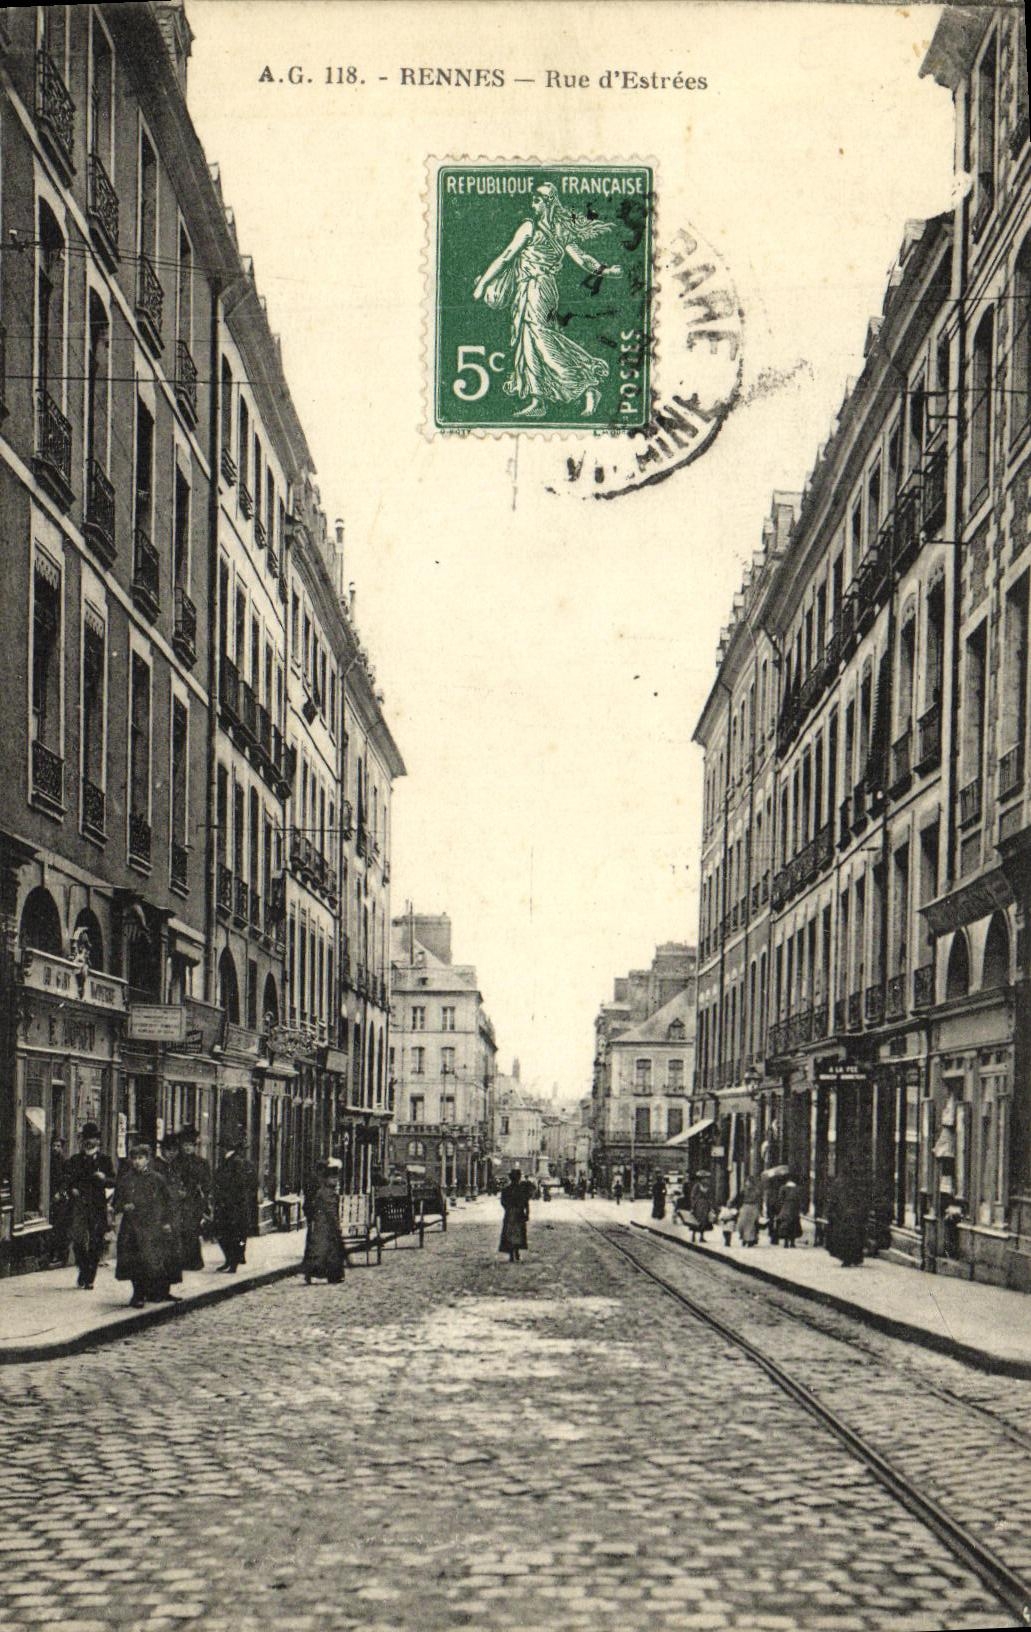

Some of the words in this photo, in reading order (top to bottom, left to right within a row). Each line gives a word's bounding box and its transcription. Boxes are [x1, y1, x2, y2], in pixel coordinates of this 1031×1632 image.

[446, 176, 535, 197] REPUBLIQUE
[562, 177, 643, 197] FRANÇAISE
[620, 329, 641, 413] POSTES
